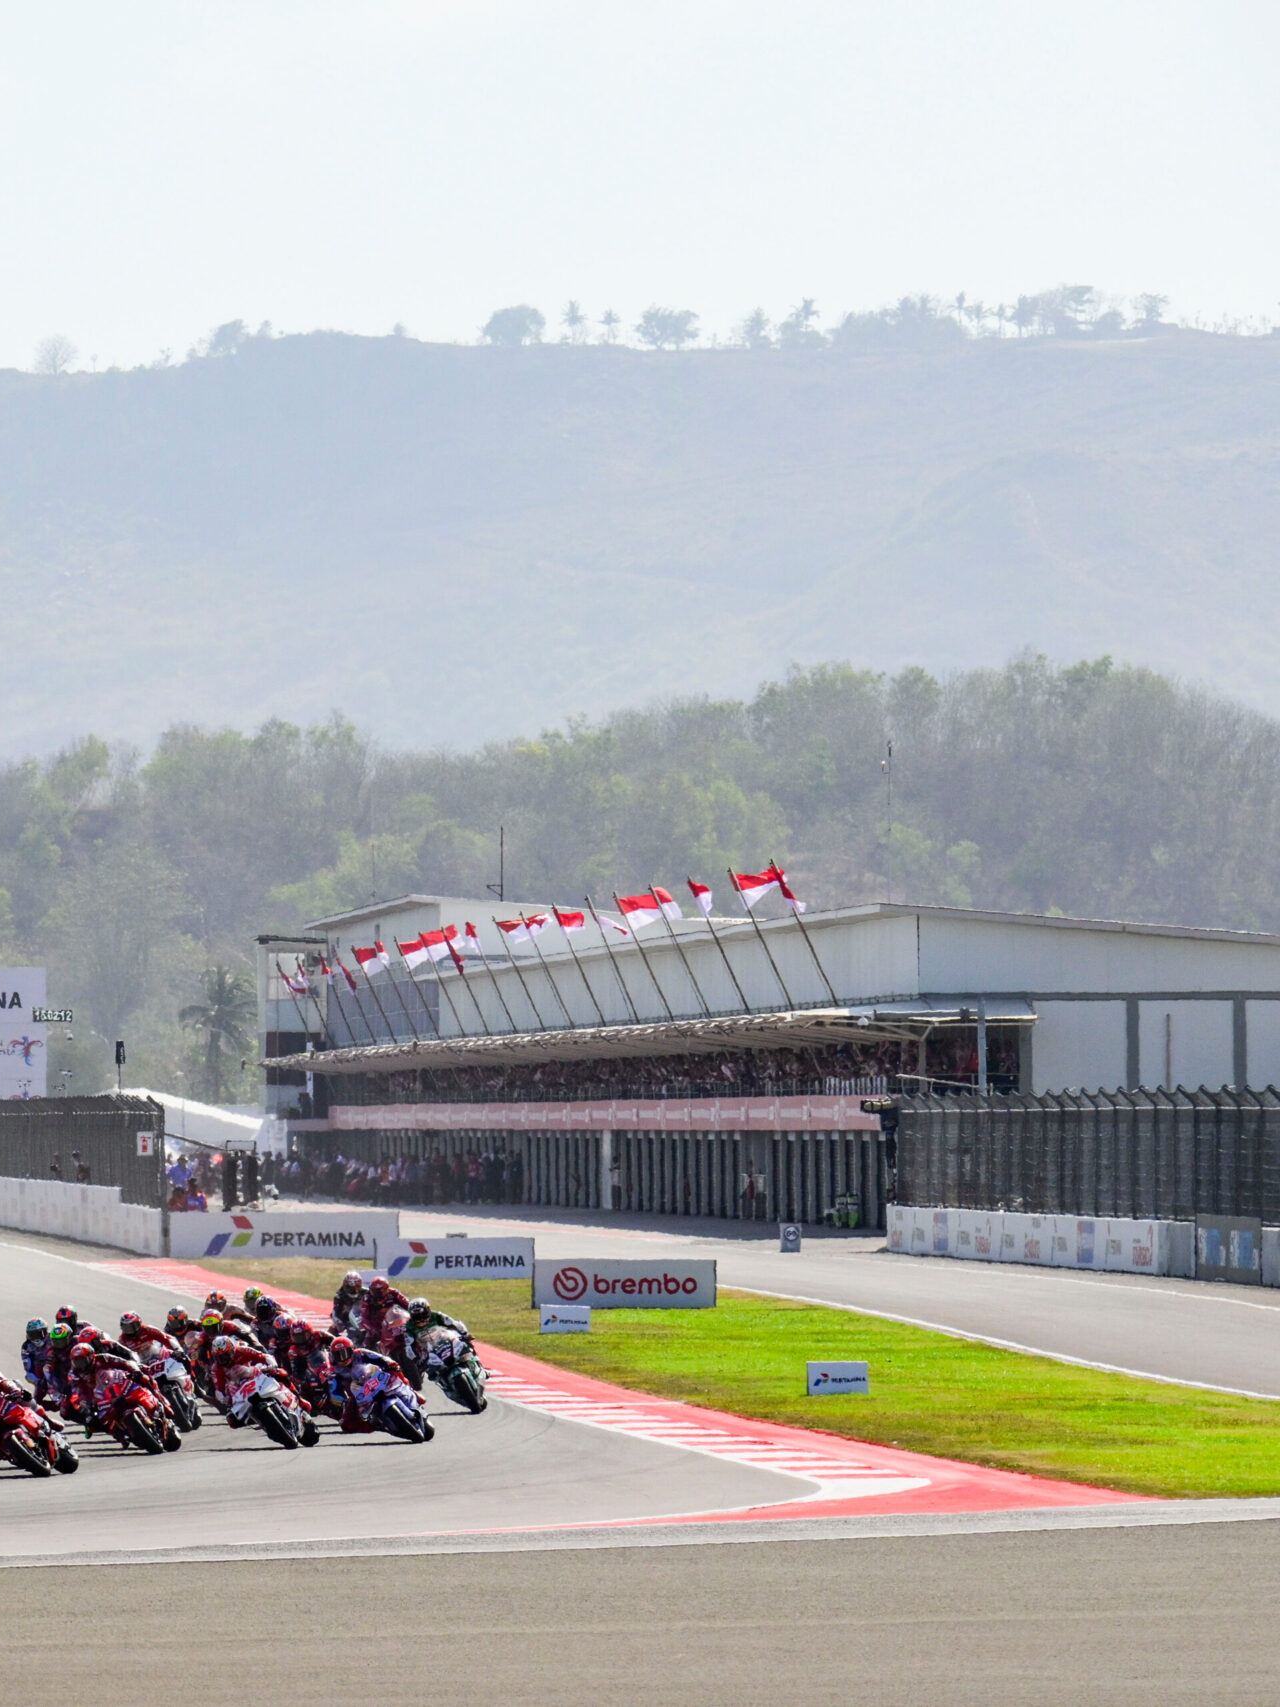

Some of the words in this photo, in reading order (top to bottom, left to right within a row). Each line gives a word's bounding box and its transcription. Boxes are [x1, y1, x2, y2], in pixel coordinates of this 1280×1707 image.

[260, 1232, 366, 1247] PERTAMINA
[434, 1255, 526, 1269] PERTAMINA
[593, 1273, 698, 1295] brembo
